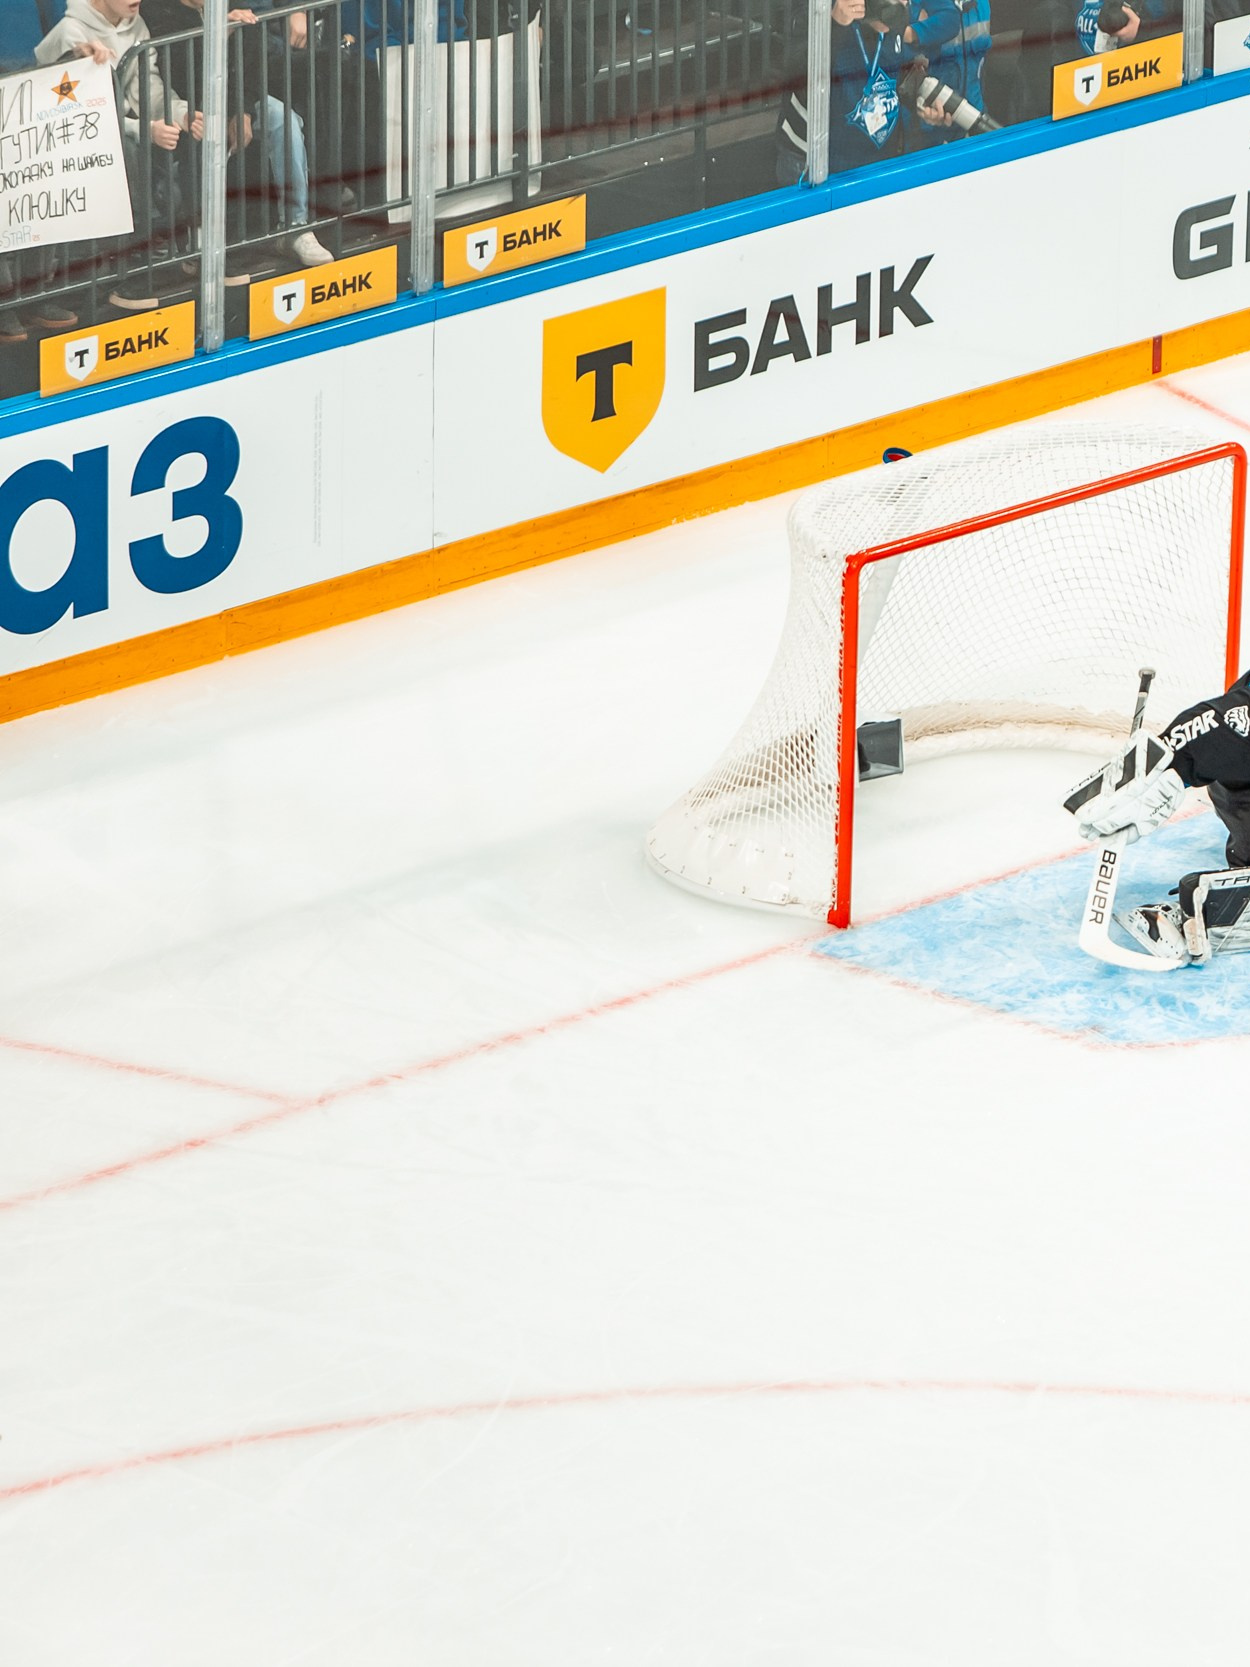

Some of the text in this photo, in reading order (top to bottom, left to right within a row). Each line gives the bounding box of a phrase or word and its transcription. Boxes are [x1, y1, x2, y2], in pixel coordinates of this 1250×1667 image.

[1107, 57, 1161, 88] БАНК
[8, 186, 87, 227] КЛЮШКУ
[502, 219, 562, 253] БАНК
[310, 271, 373, 305] БАНК
[694, 253, 936, 393] БАНК
[104, 327, 170, 362] БАНК
